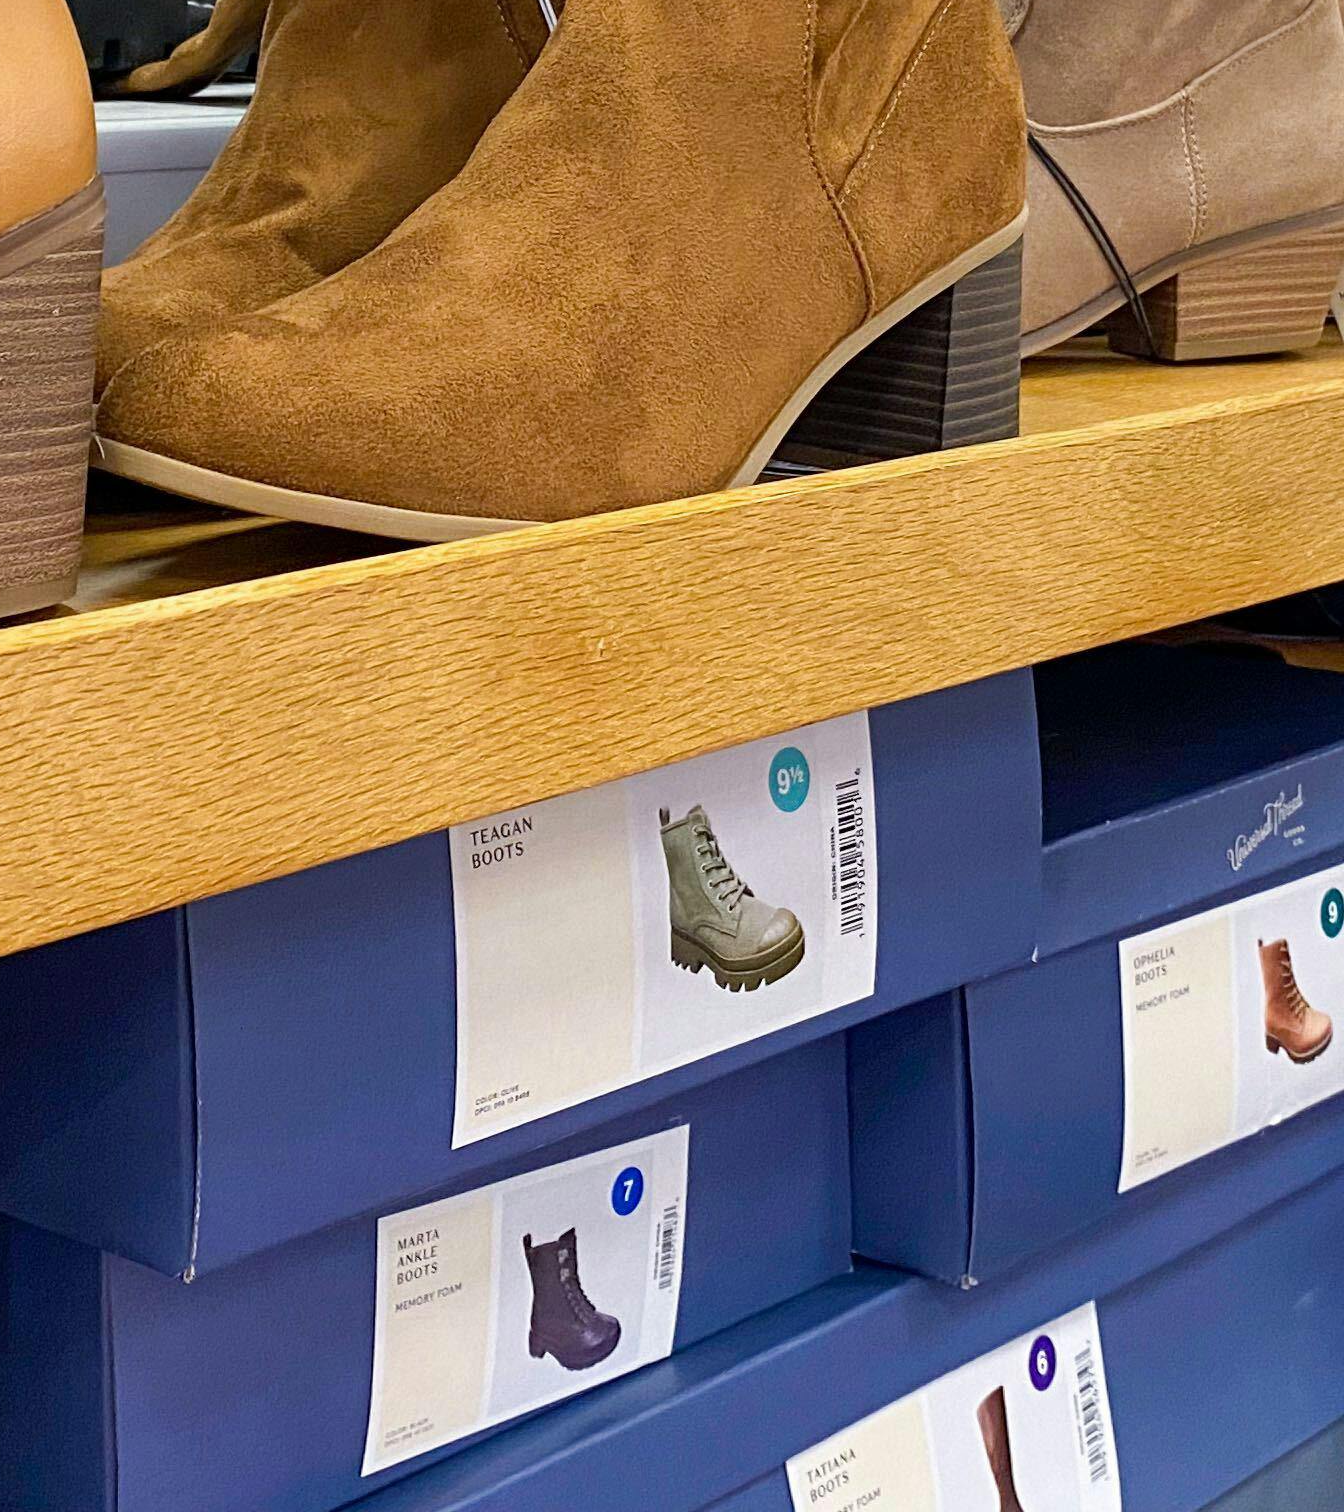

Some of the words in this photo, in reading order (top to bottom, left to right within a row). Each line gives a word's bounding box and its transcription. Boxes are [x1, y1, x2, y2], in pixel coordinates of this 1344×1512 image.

[469, 815, 533, 847] TEAGAN
[471, 841, 525, 870] BOOTS
[1328, 900, 1338, 924] 9
[1133, 946, 1176, 970] OPHELIA
[1135, 964, 1167, 986] BOOTS
[623, 1179, 634, 1202] 7
[397, 1228, 440, 1252] MARTA
[397, 1245, 439, 1268] ANKLE
[396, 1261, 439, 1286] BOOTS
[395, 1291, 435, 1313] MEMORY
[436, 1281, 462, 1298] FOAM
[1037, 1349, 1049, 1376] 6
[807, 1448, 856, 1484] TATIANA
[809, 1470, 849, 1504] BOOTS
[856, 1487, 881, 1509] FOAM
